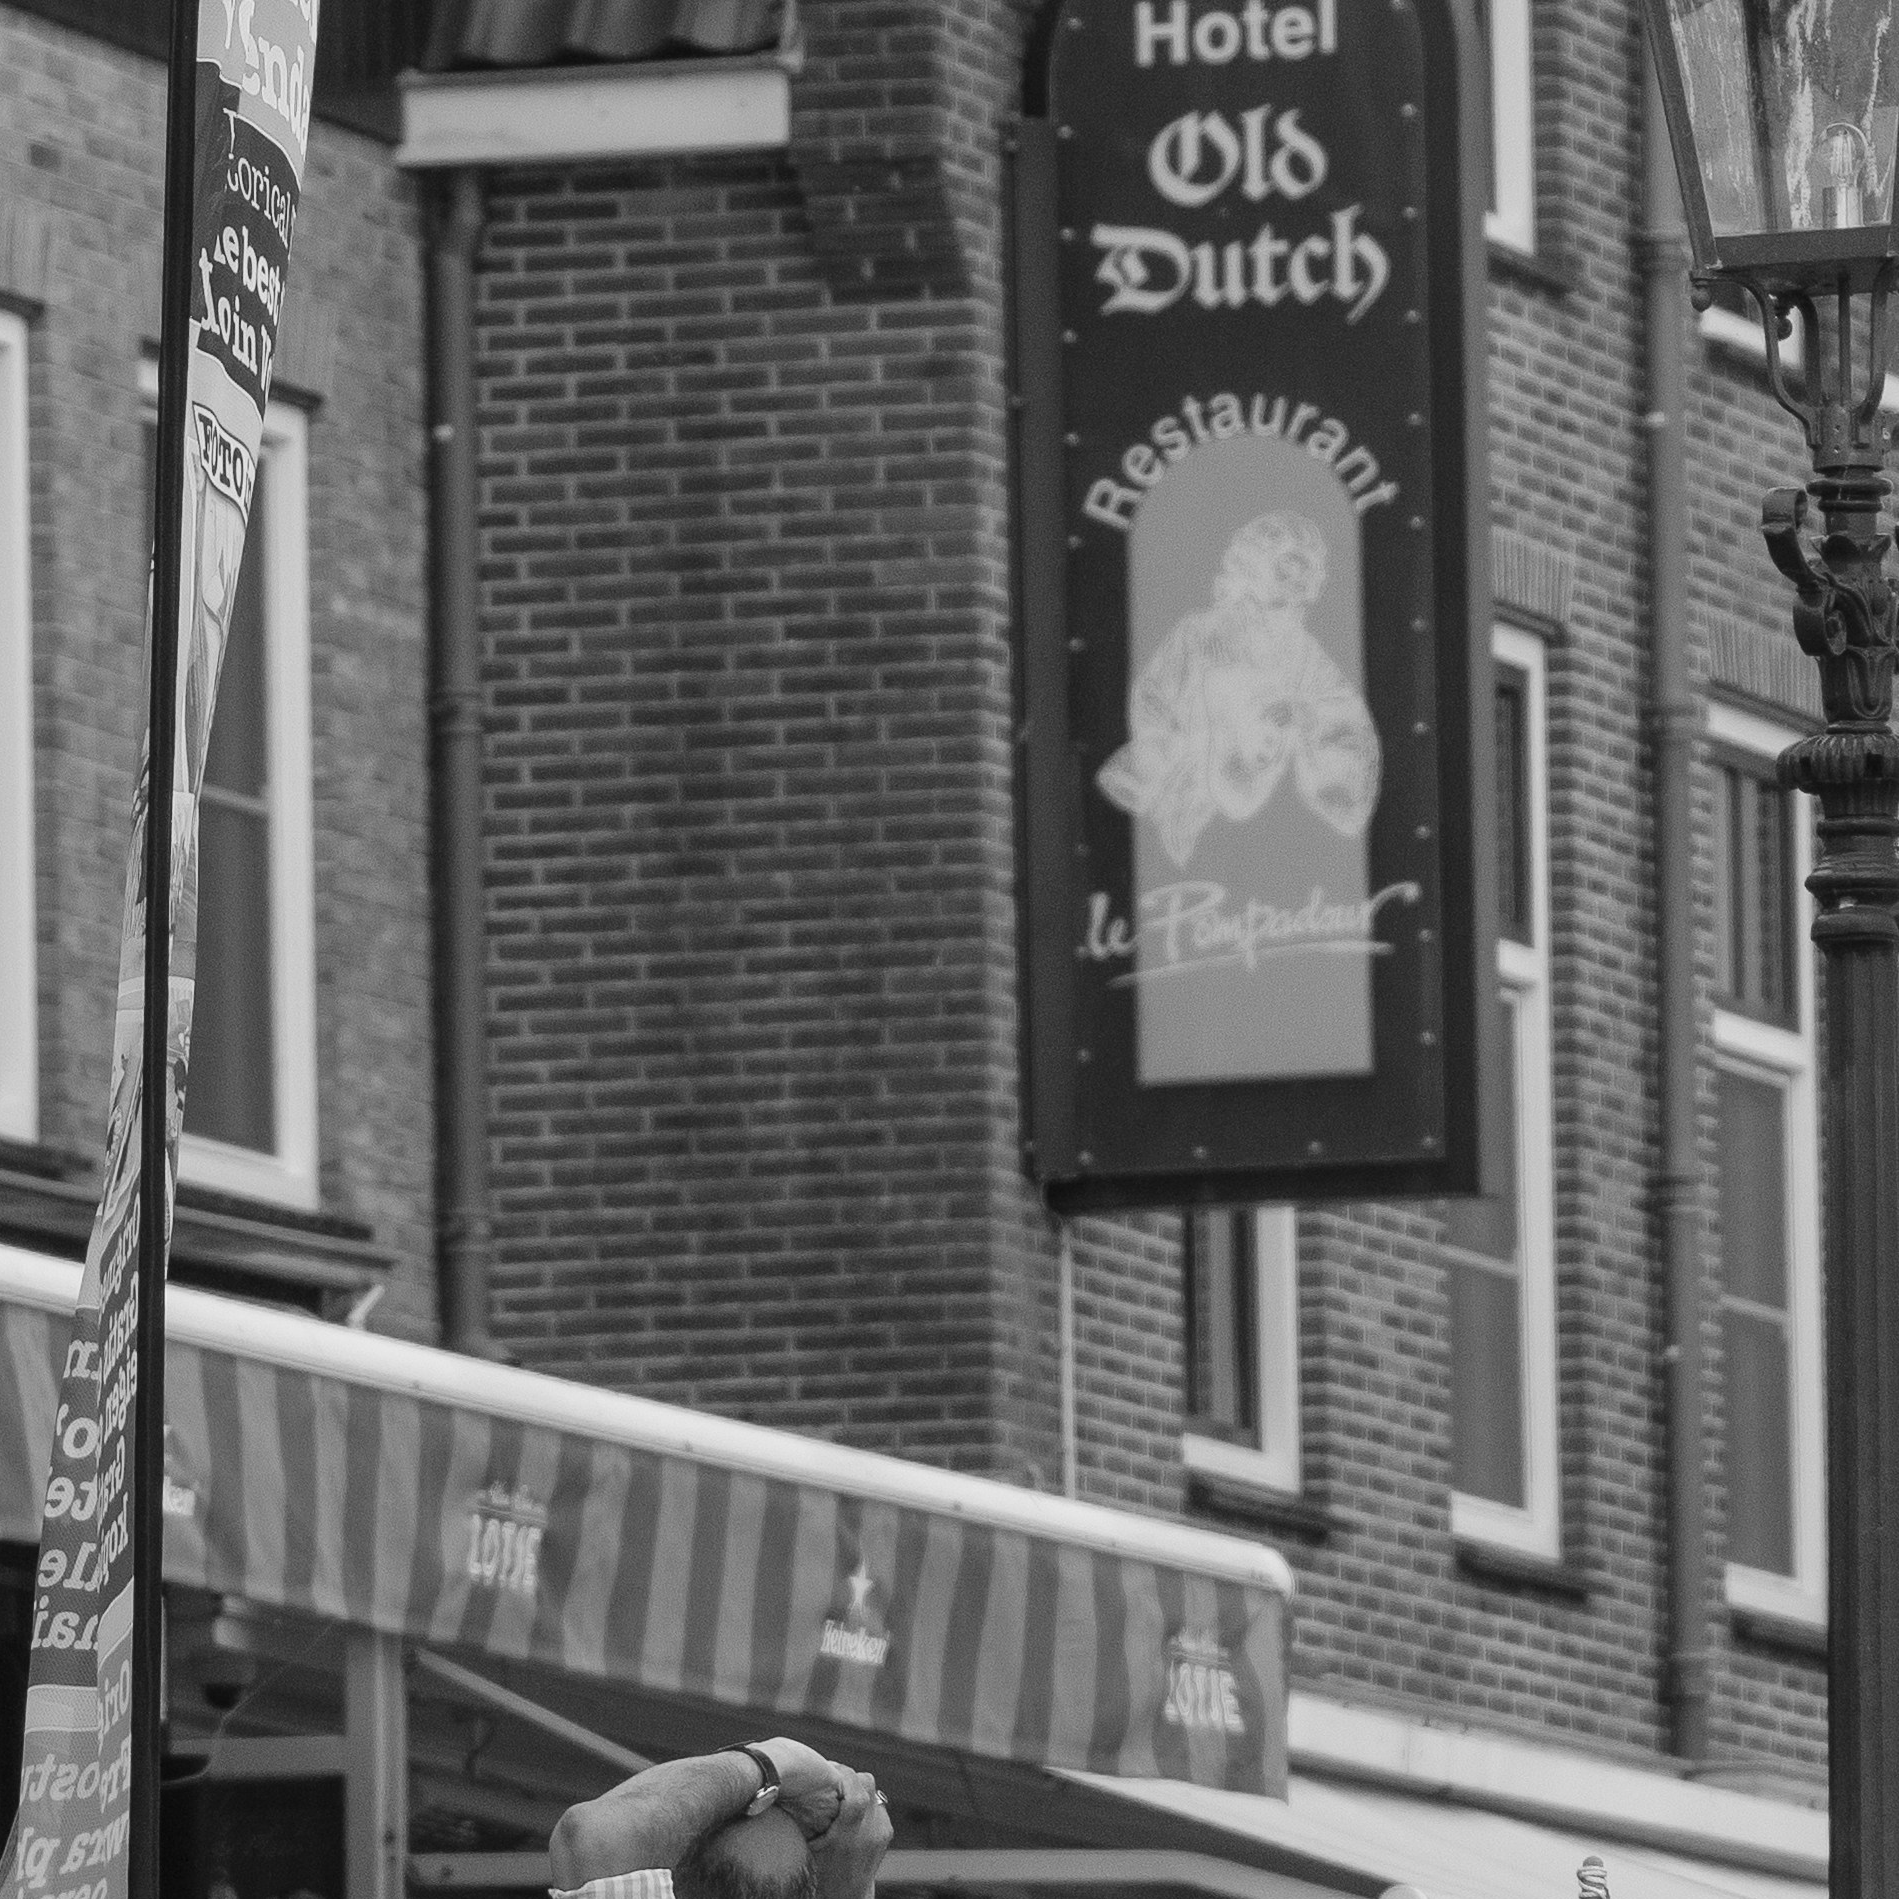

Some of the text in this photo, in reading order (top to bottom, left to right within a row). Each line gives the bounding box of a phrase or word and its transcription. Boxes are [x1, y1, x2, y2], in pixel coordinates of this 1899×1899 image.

[1134, 0, 1337, 67] Hotel
[1148, 103, 1329, 208] Old
[1091, 204, 1391, 325] Dutch
[1082, 392, 1399, 530] Restaurant
[467, 1513, 541, 1593] LOTJE
